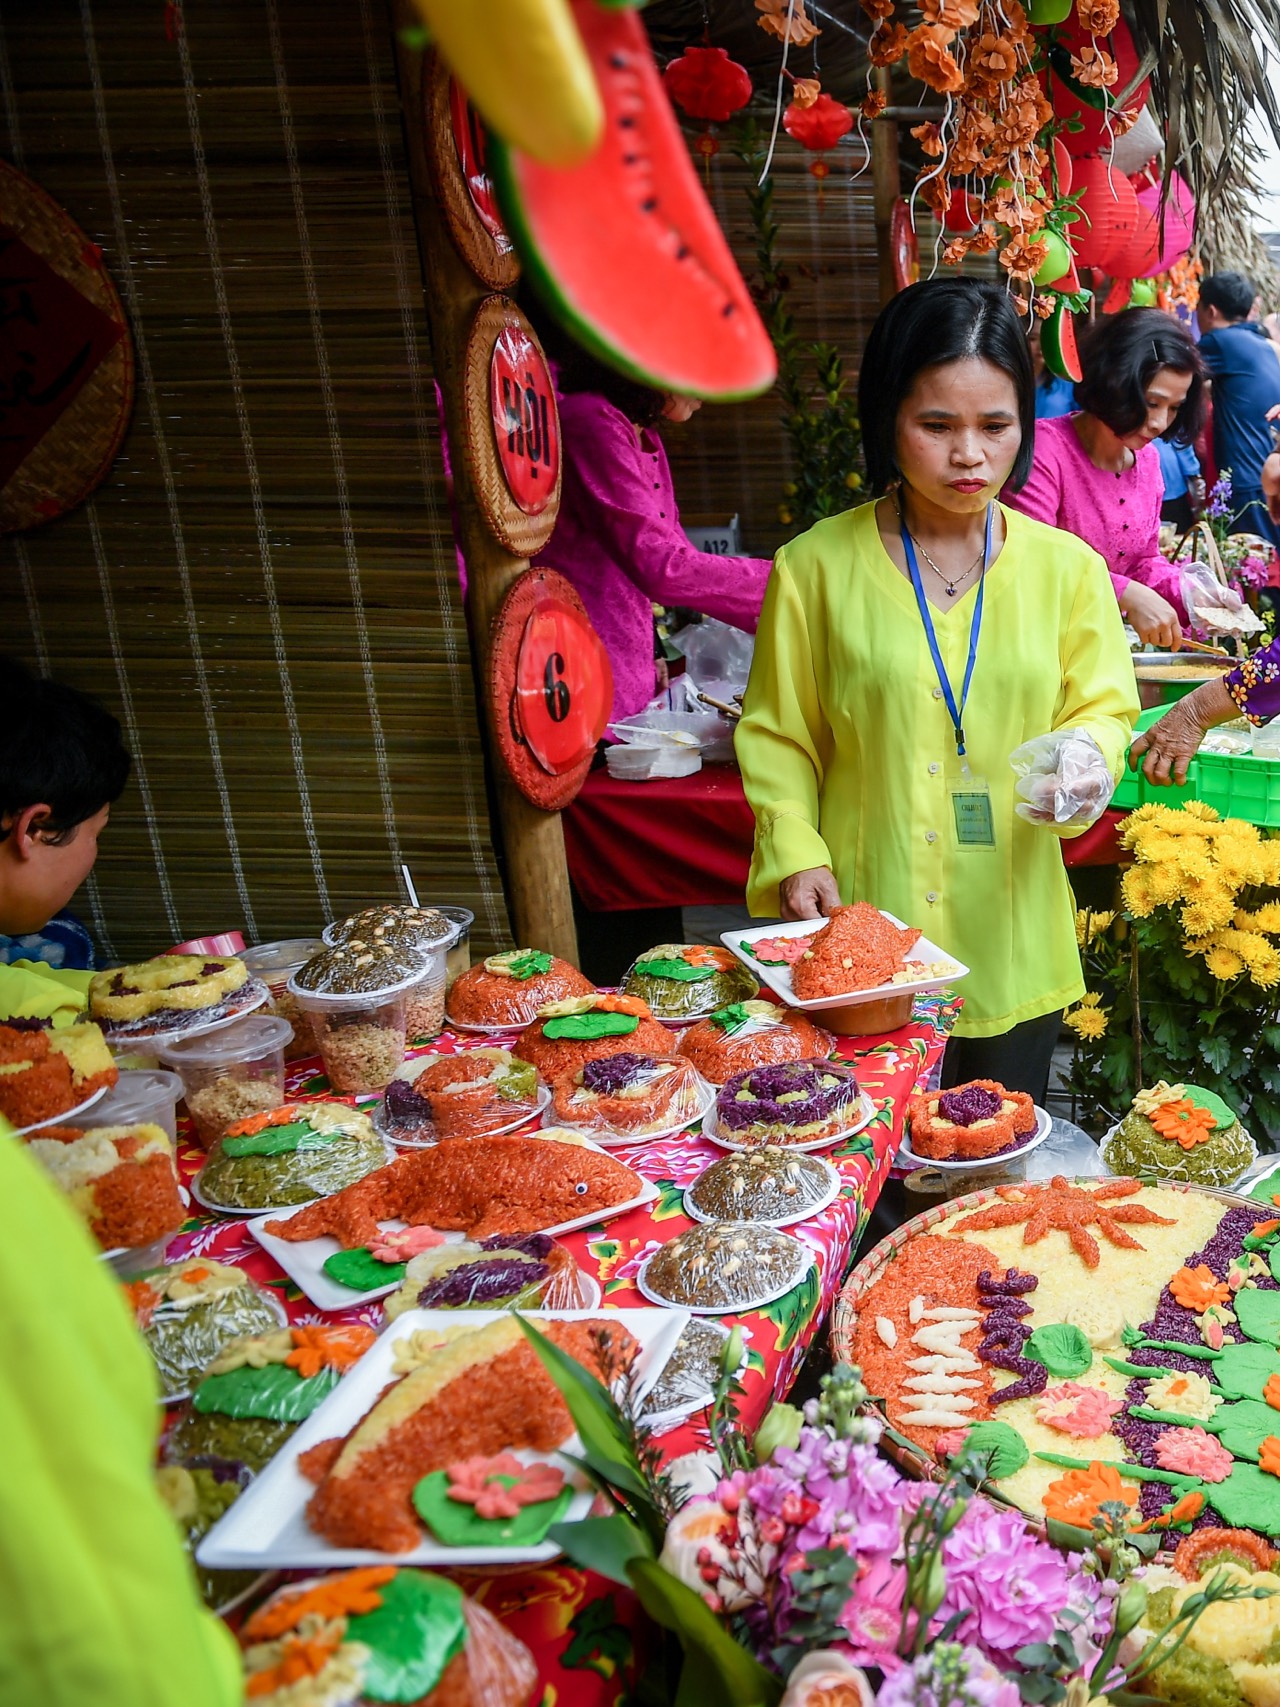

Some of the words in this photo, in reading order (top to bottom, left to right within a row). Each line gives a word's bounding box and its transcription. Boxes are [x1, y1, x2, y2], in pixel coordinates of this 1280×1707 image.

[503, 372, 550, 479] HỘI
[704, 540, 729, 555] A12
[545, 653, 570, 723] 6
